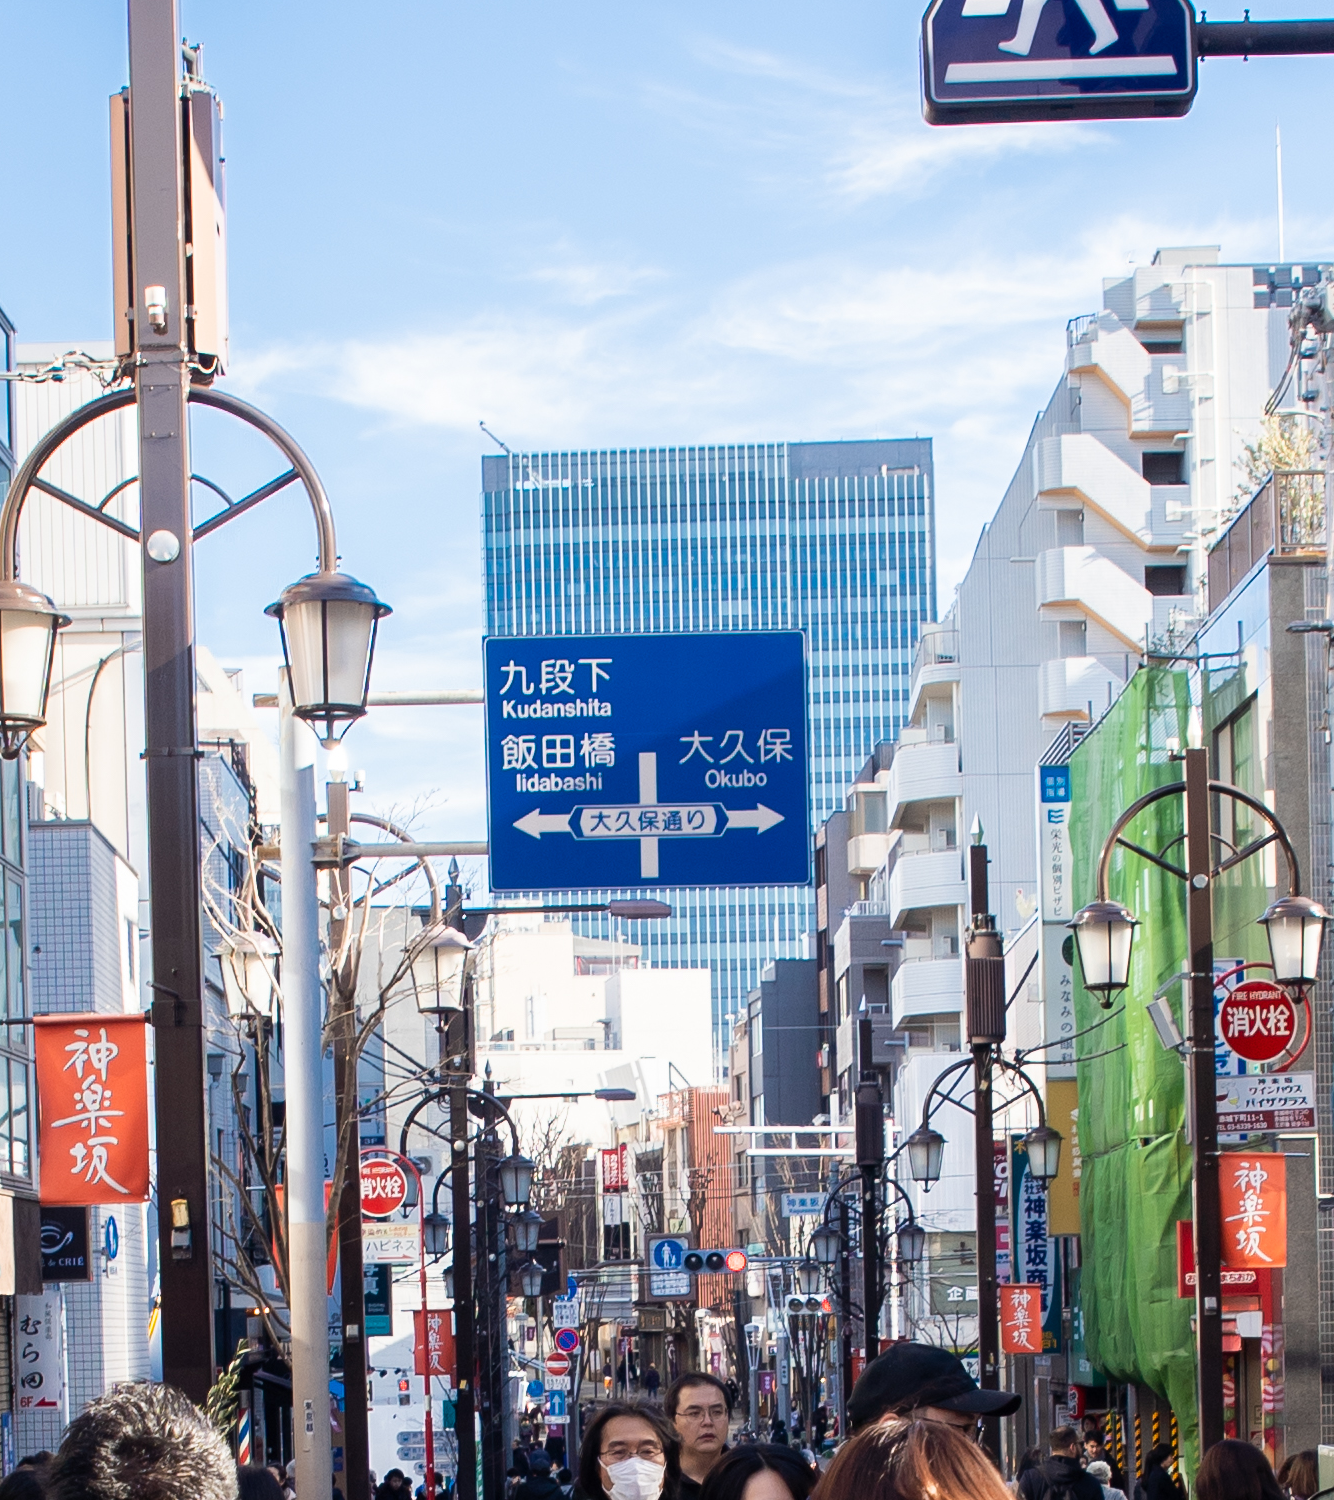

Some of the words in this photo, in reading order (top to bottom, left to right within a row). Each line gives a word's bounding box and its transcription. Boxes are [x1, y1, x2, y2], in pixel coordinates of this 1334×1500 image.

[499, 657, 613, 695] 九段下
[502, 699, 612, 719] Kudanshita
[500, 732, 616, 770] 飯田橋
[678, 728, 794, 765] 大久保
[516, 772, 603, 793] Iidabashi
[704, 768, 768, 789] Okubo
[589, 809, 706, 834] 大久保通り
[1226, 1003, 1291, 1038] 消火栓
[51, 1027, 132, 1195] 神楽坂
[1224, 1161, 1274, 1263] 神楽坂
[1005, 1289, 1035, 1350] 神楽坂
[19, 1396, 34, 1408] 6F
